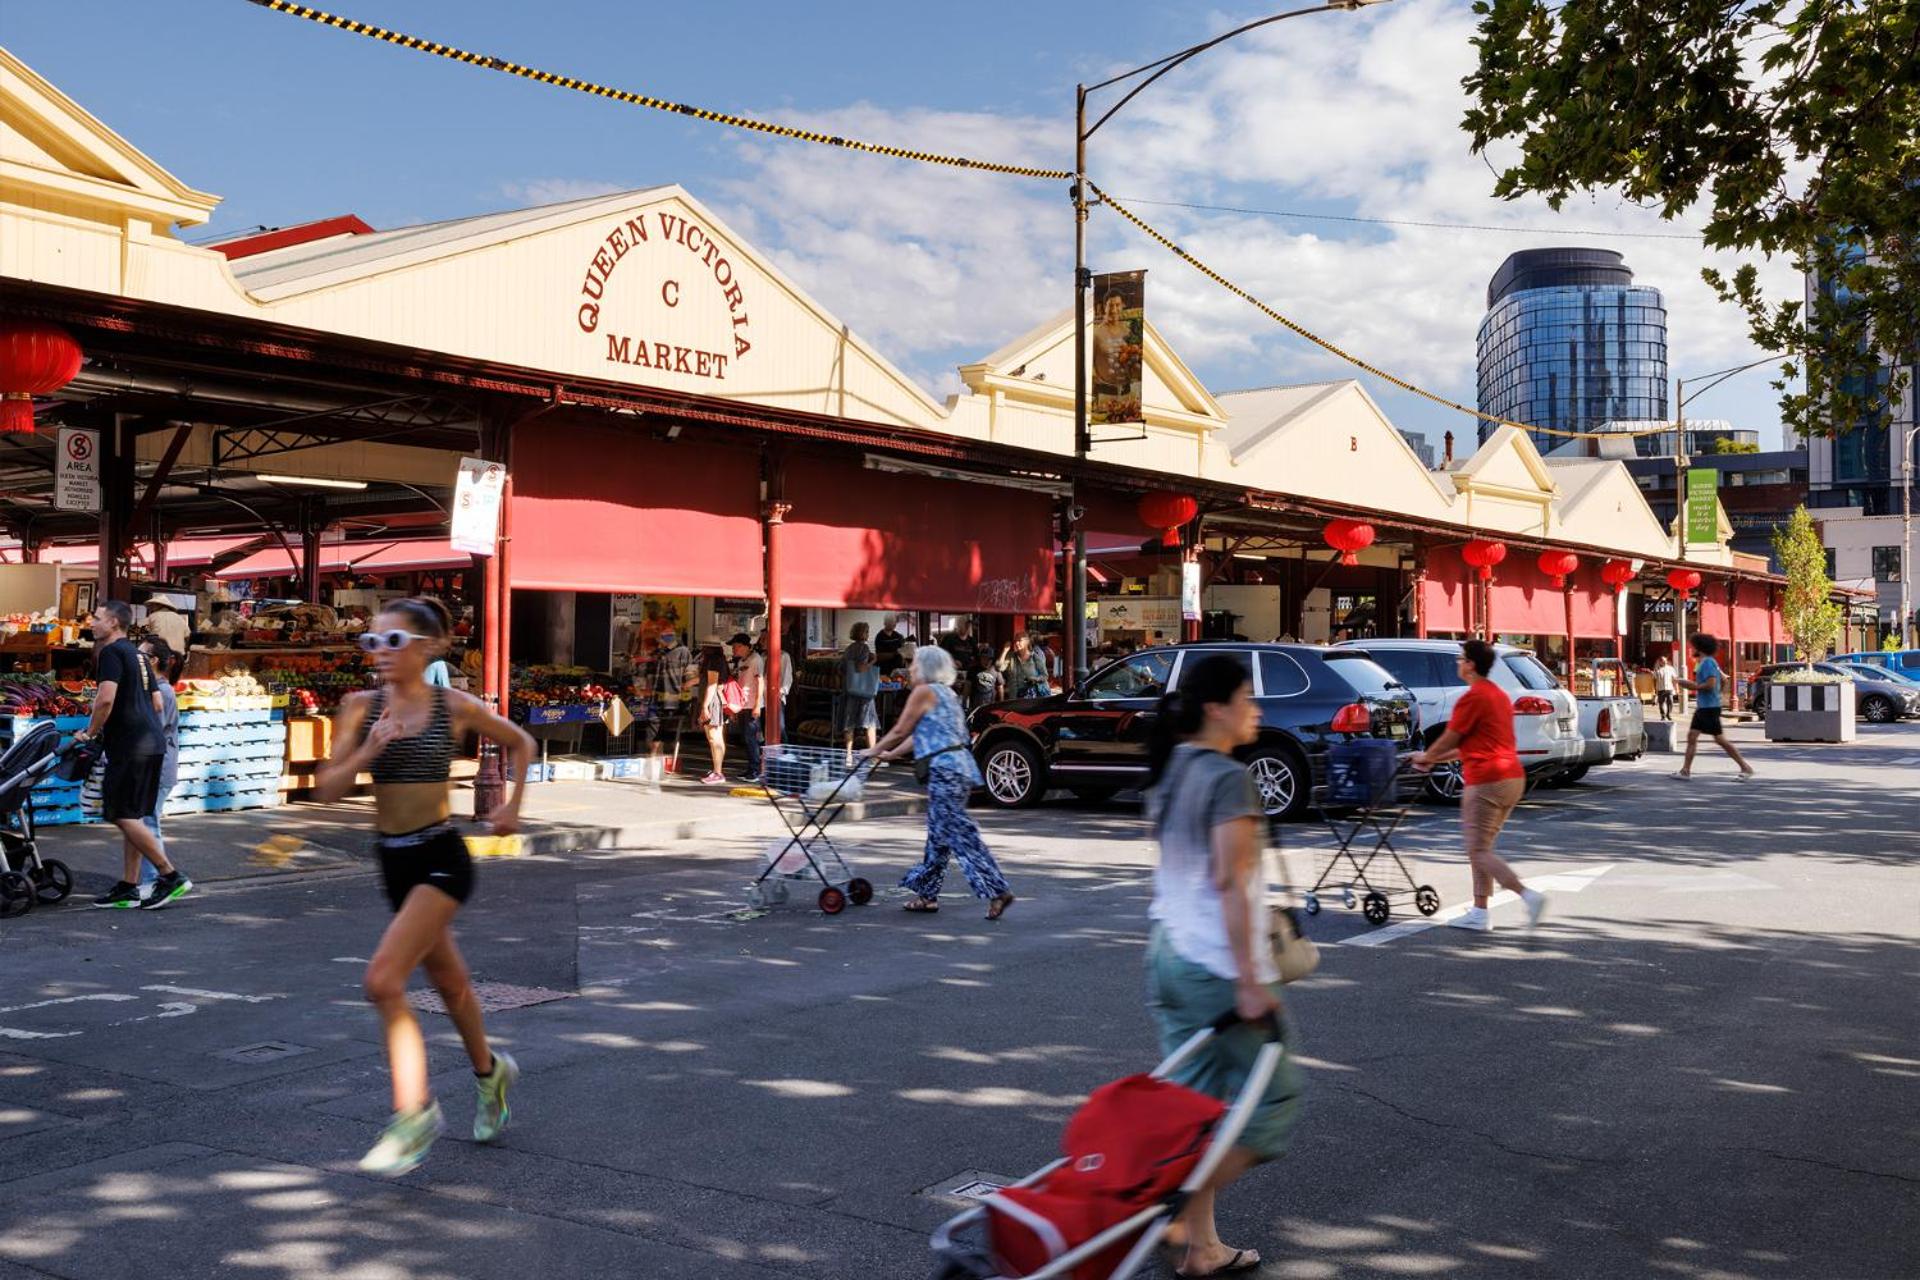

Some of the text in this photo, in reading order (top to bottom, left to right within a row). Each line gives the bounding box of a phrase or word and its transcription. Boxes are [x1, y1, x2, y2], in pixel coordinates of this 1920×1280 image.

[577, 212, 752, 360] QUEEN VICTORIA
[661, 280, 680, 308] C
[606, 333, 728, 380] MARKET
[1350, 436, 1358, 452] B
[66, 461, 92, 472] AREA
[115, 565, 128, 579] 14
